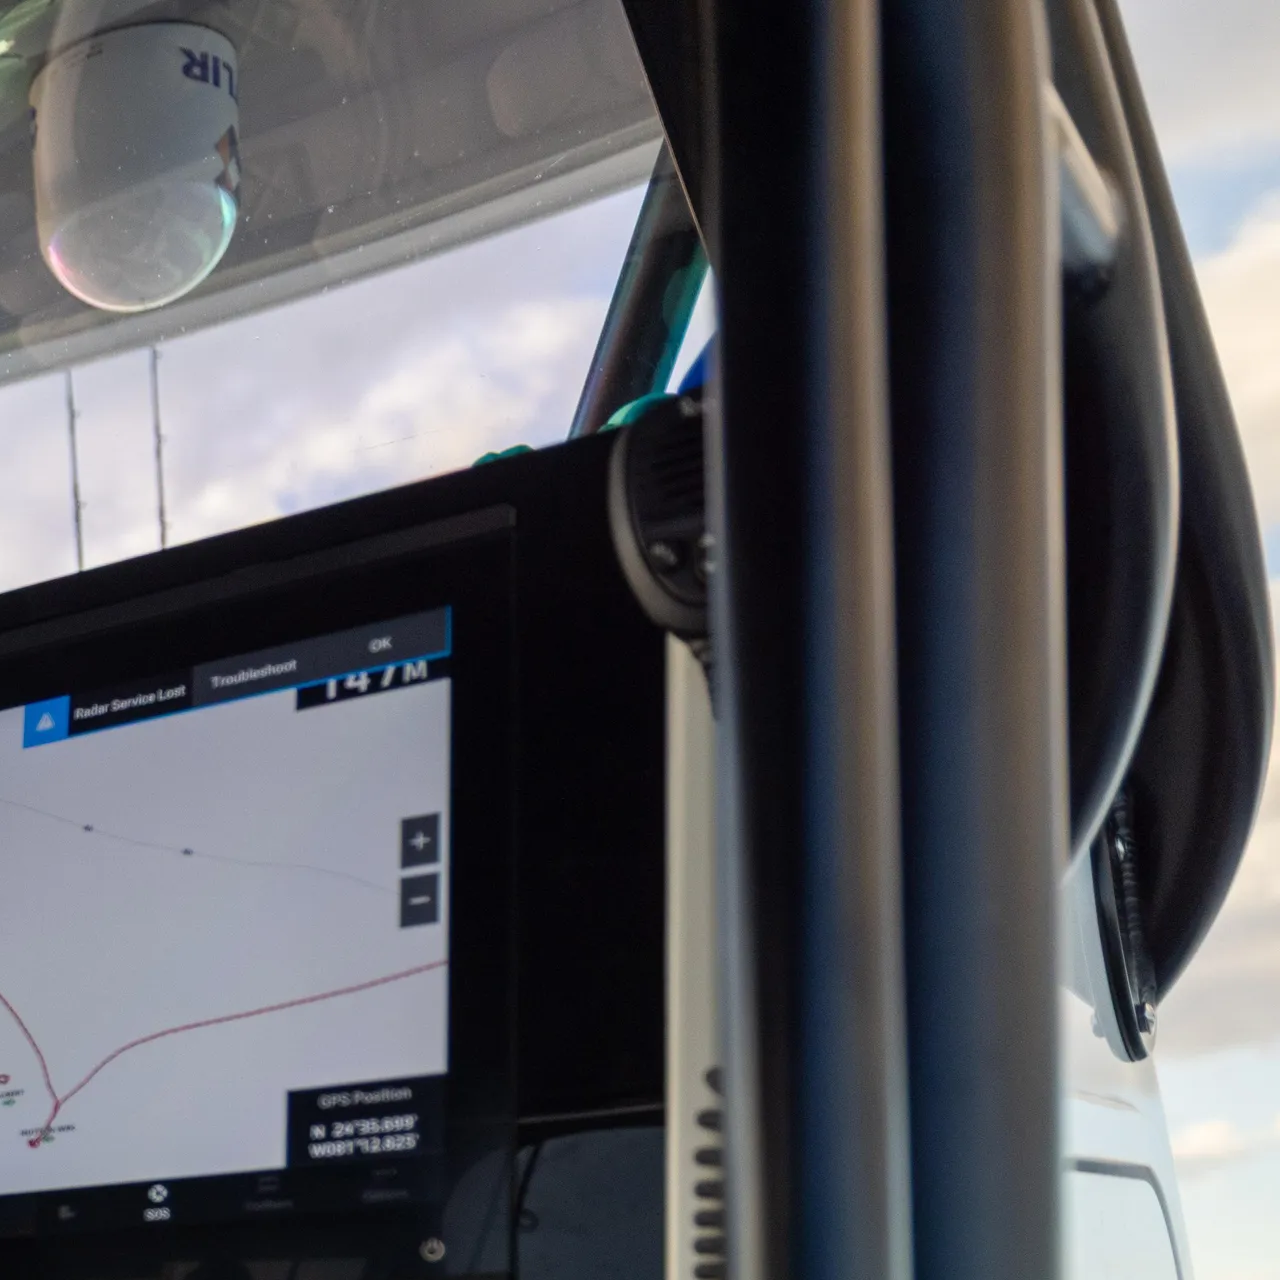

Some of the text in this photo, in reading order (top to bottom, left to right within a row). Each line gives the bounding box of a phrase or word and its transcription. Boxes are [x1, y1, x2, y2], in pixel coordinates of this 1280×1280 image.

[368, 637, 393, 652] OK
[210, 659, 298, 688] Troubleshoot
[73, 684, 187, 721] Radar Service Lost
[317, 1086, 413, 1109] GPS Position
[309, 1123, 326, 1140] N
[143, 1207, 171, 1222] SOS
